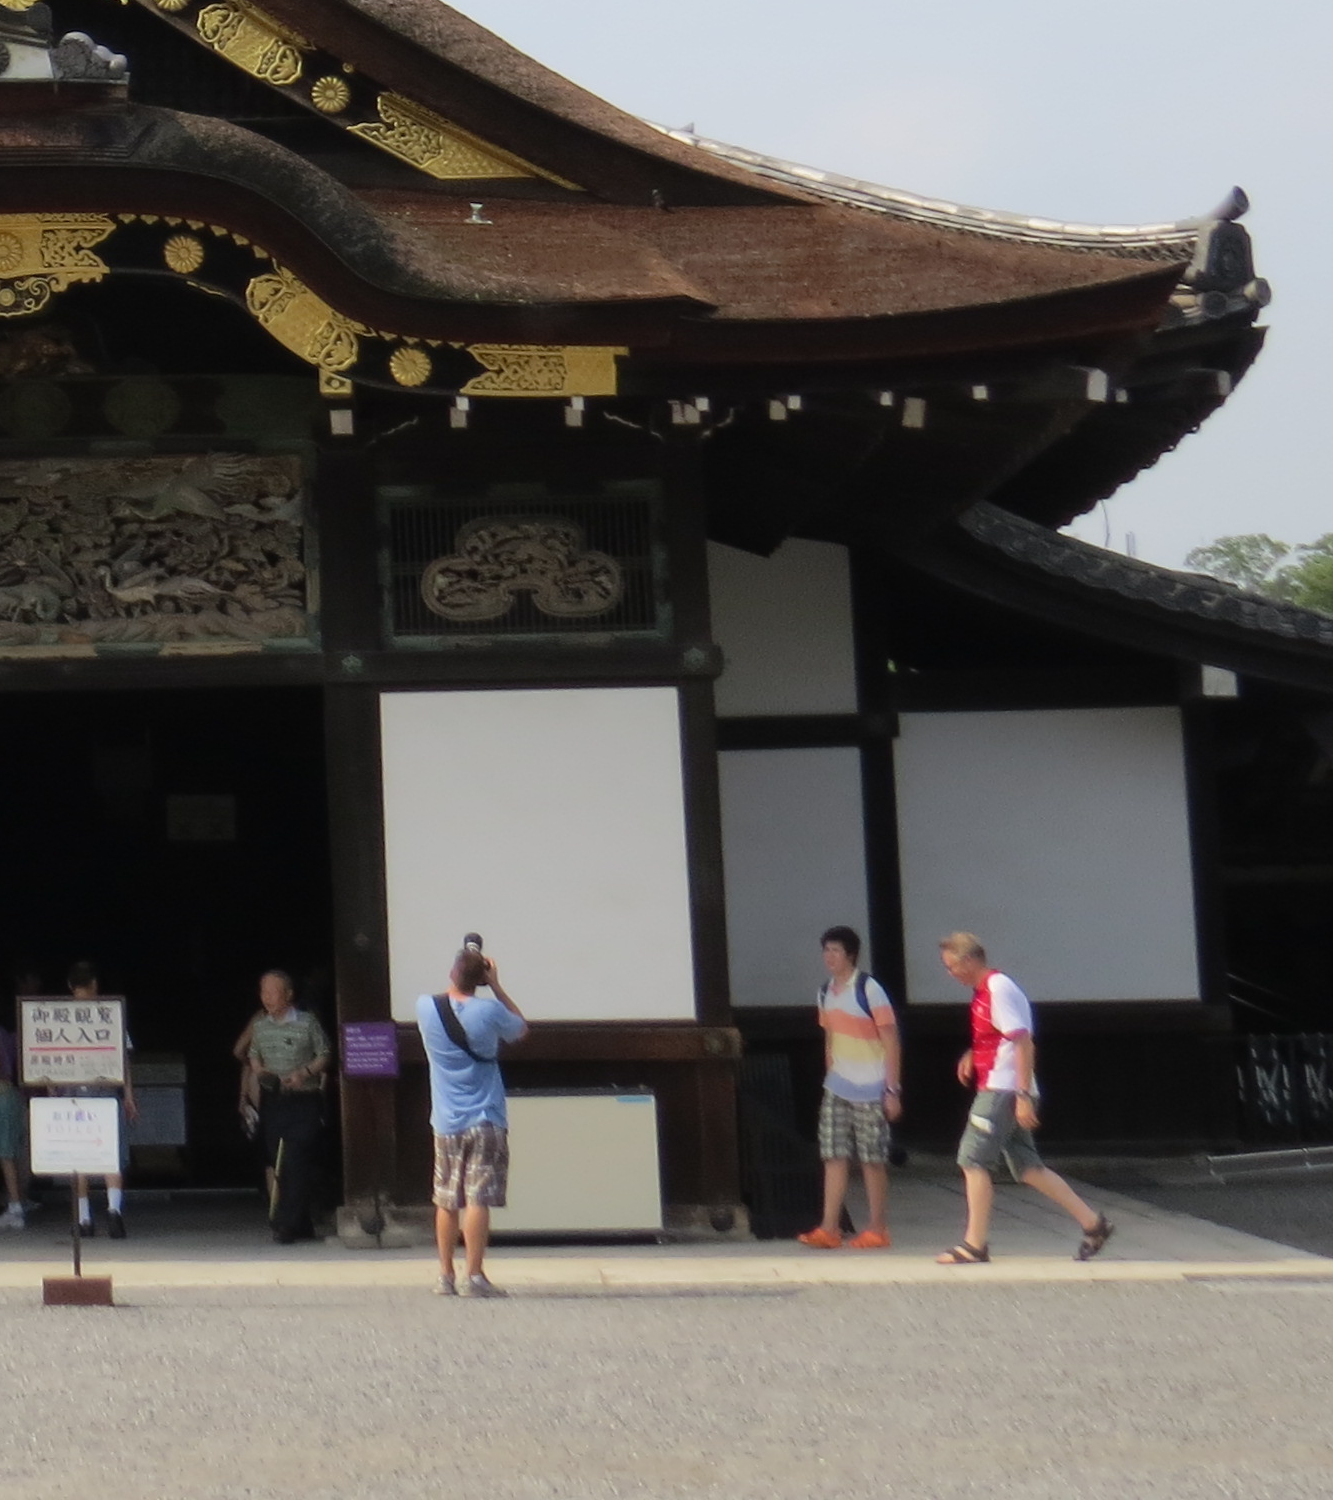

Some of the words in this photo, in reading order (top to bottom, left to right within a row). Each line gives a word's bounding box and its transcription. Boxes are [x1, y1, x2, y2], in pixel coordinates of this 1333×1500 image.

[32, 1006, 113, 1024] 御殿観覧
[35, 1027, 110, 1043] 個人入口
